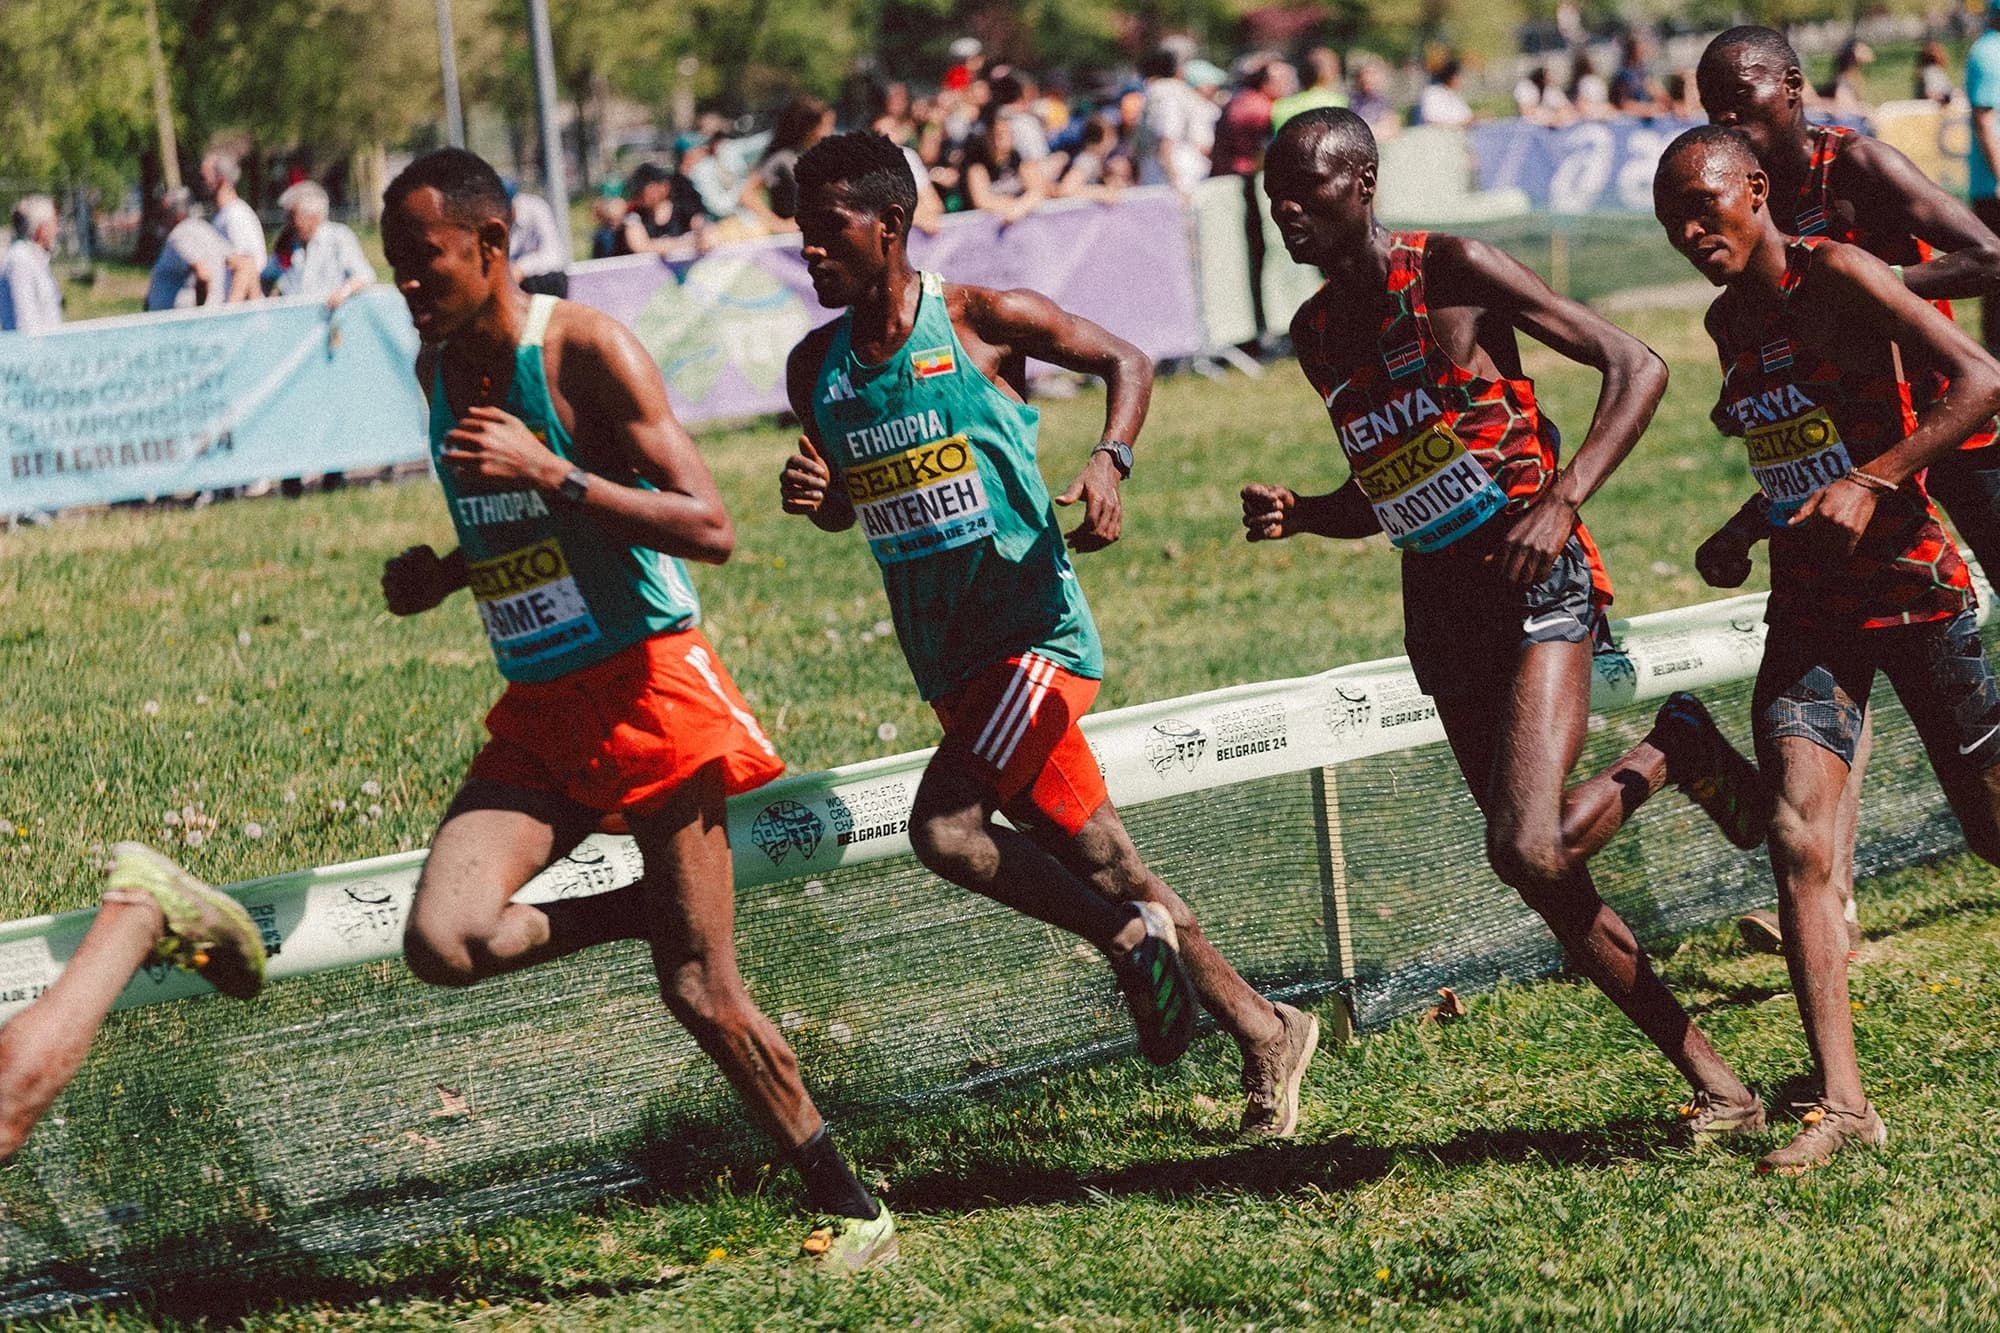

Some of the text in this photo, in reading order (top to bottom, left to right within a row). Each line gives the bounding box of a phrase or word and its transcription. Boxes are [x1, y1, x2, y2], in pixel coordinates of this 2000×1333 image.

[846, 409, 947, 459] ETHIOPIA
[1340, 388, 1442, 457] KENYA
[11, 438, 176, 478] BELGRADE
[845, 443, 968, 499] SEIKO
[456, 489, 550, 527] ETHIOPIA
[862, 479, 979, 536] ANTENEH
[966, 516, 989, 533] 24
[1211, 702, 1286, 725] WORLD ATHLETICS
[1216, 711, 1287, 736] CROSS COUNTRY
[1381, 706, 1436, 729] BELGRADE 24
[1217, 724, 1287, 748] CHAMPIONSHIPS
[1217, 736, 1288, 762] BELGRADE 24
[825, 782, 906, 809] WORLD ATHLETICS
[829, 793, 909, 821] CROSS COUNTRY
[833, 805, 912, 832] CHAMPIONSHIPS
[837, 820, 908, 847] BELGRADE 2
